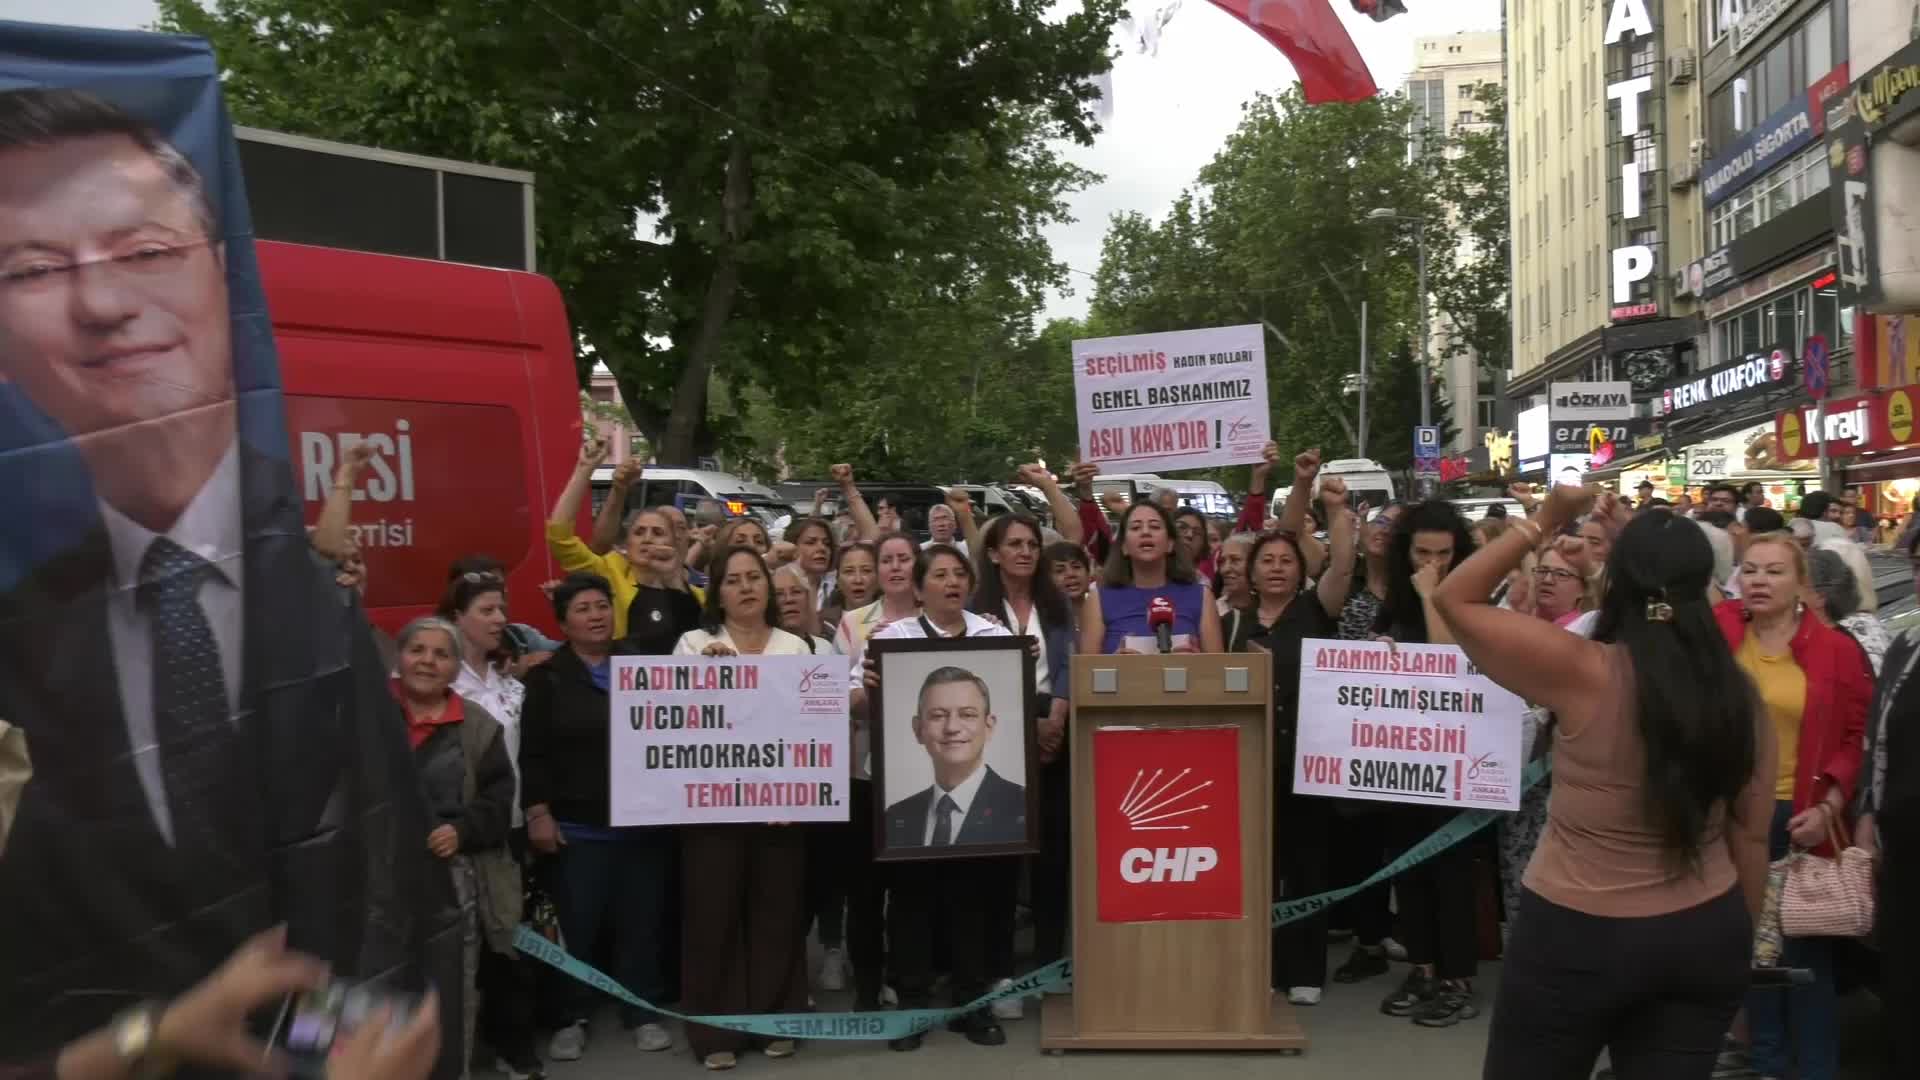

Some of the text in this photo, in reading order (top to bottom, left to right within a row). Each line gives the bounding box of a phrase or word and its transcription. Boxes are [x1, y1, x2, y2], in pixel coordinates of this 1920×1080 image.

[1086, 349, 1253, 377] SEÇİLMİŞ KADIN KOLLARI
[1092, 378, 1252, 411] GENEL BAŞKANIMIZ
[1673, 353, 1767, 410] RENK KUAFÖR
[1090, 426, 1125, 457] ASU
[1131, 420, 1209, 454] KAYA'DIR
[1423, 430, 1433, 443] D
[1693, 459, 1713, 475] 20
[812, 672, 829, 681] CHP
[1315, 647, 1457, 675] ATANMIŞLARIN
[619, 665, 760, 691] KADINLARIN
[1337, 684, 1483, 714] SEÇİLMİŞLERİN
[630, 700, 733, 731] VİCDANI.
[1351, 718, 1466, 754] İDARESİNİ
[646, 738, 833, 770] DEMOKRASİ'NİN
[1481, 760, 1497, 768] CHP
[1303, 755, 1343, 785] YOK
[1349, 758, 1448, 794] SAYAMAZ
[684, 777, 840, 808] TEMİNATIDIR.
[1119, 846, 1218, 884] CHP
